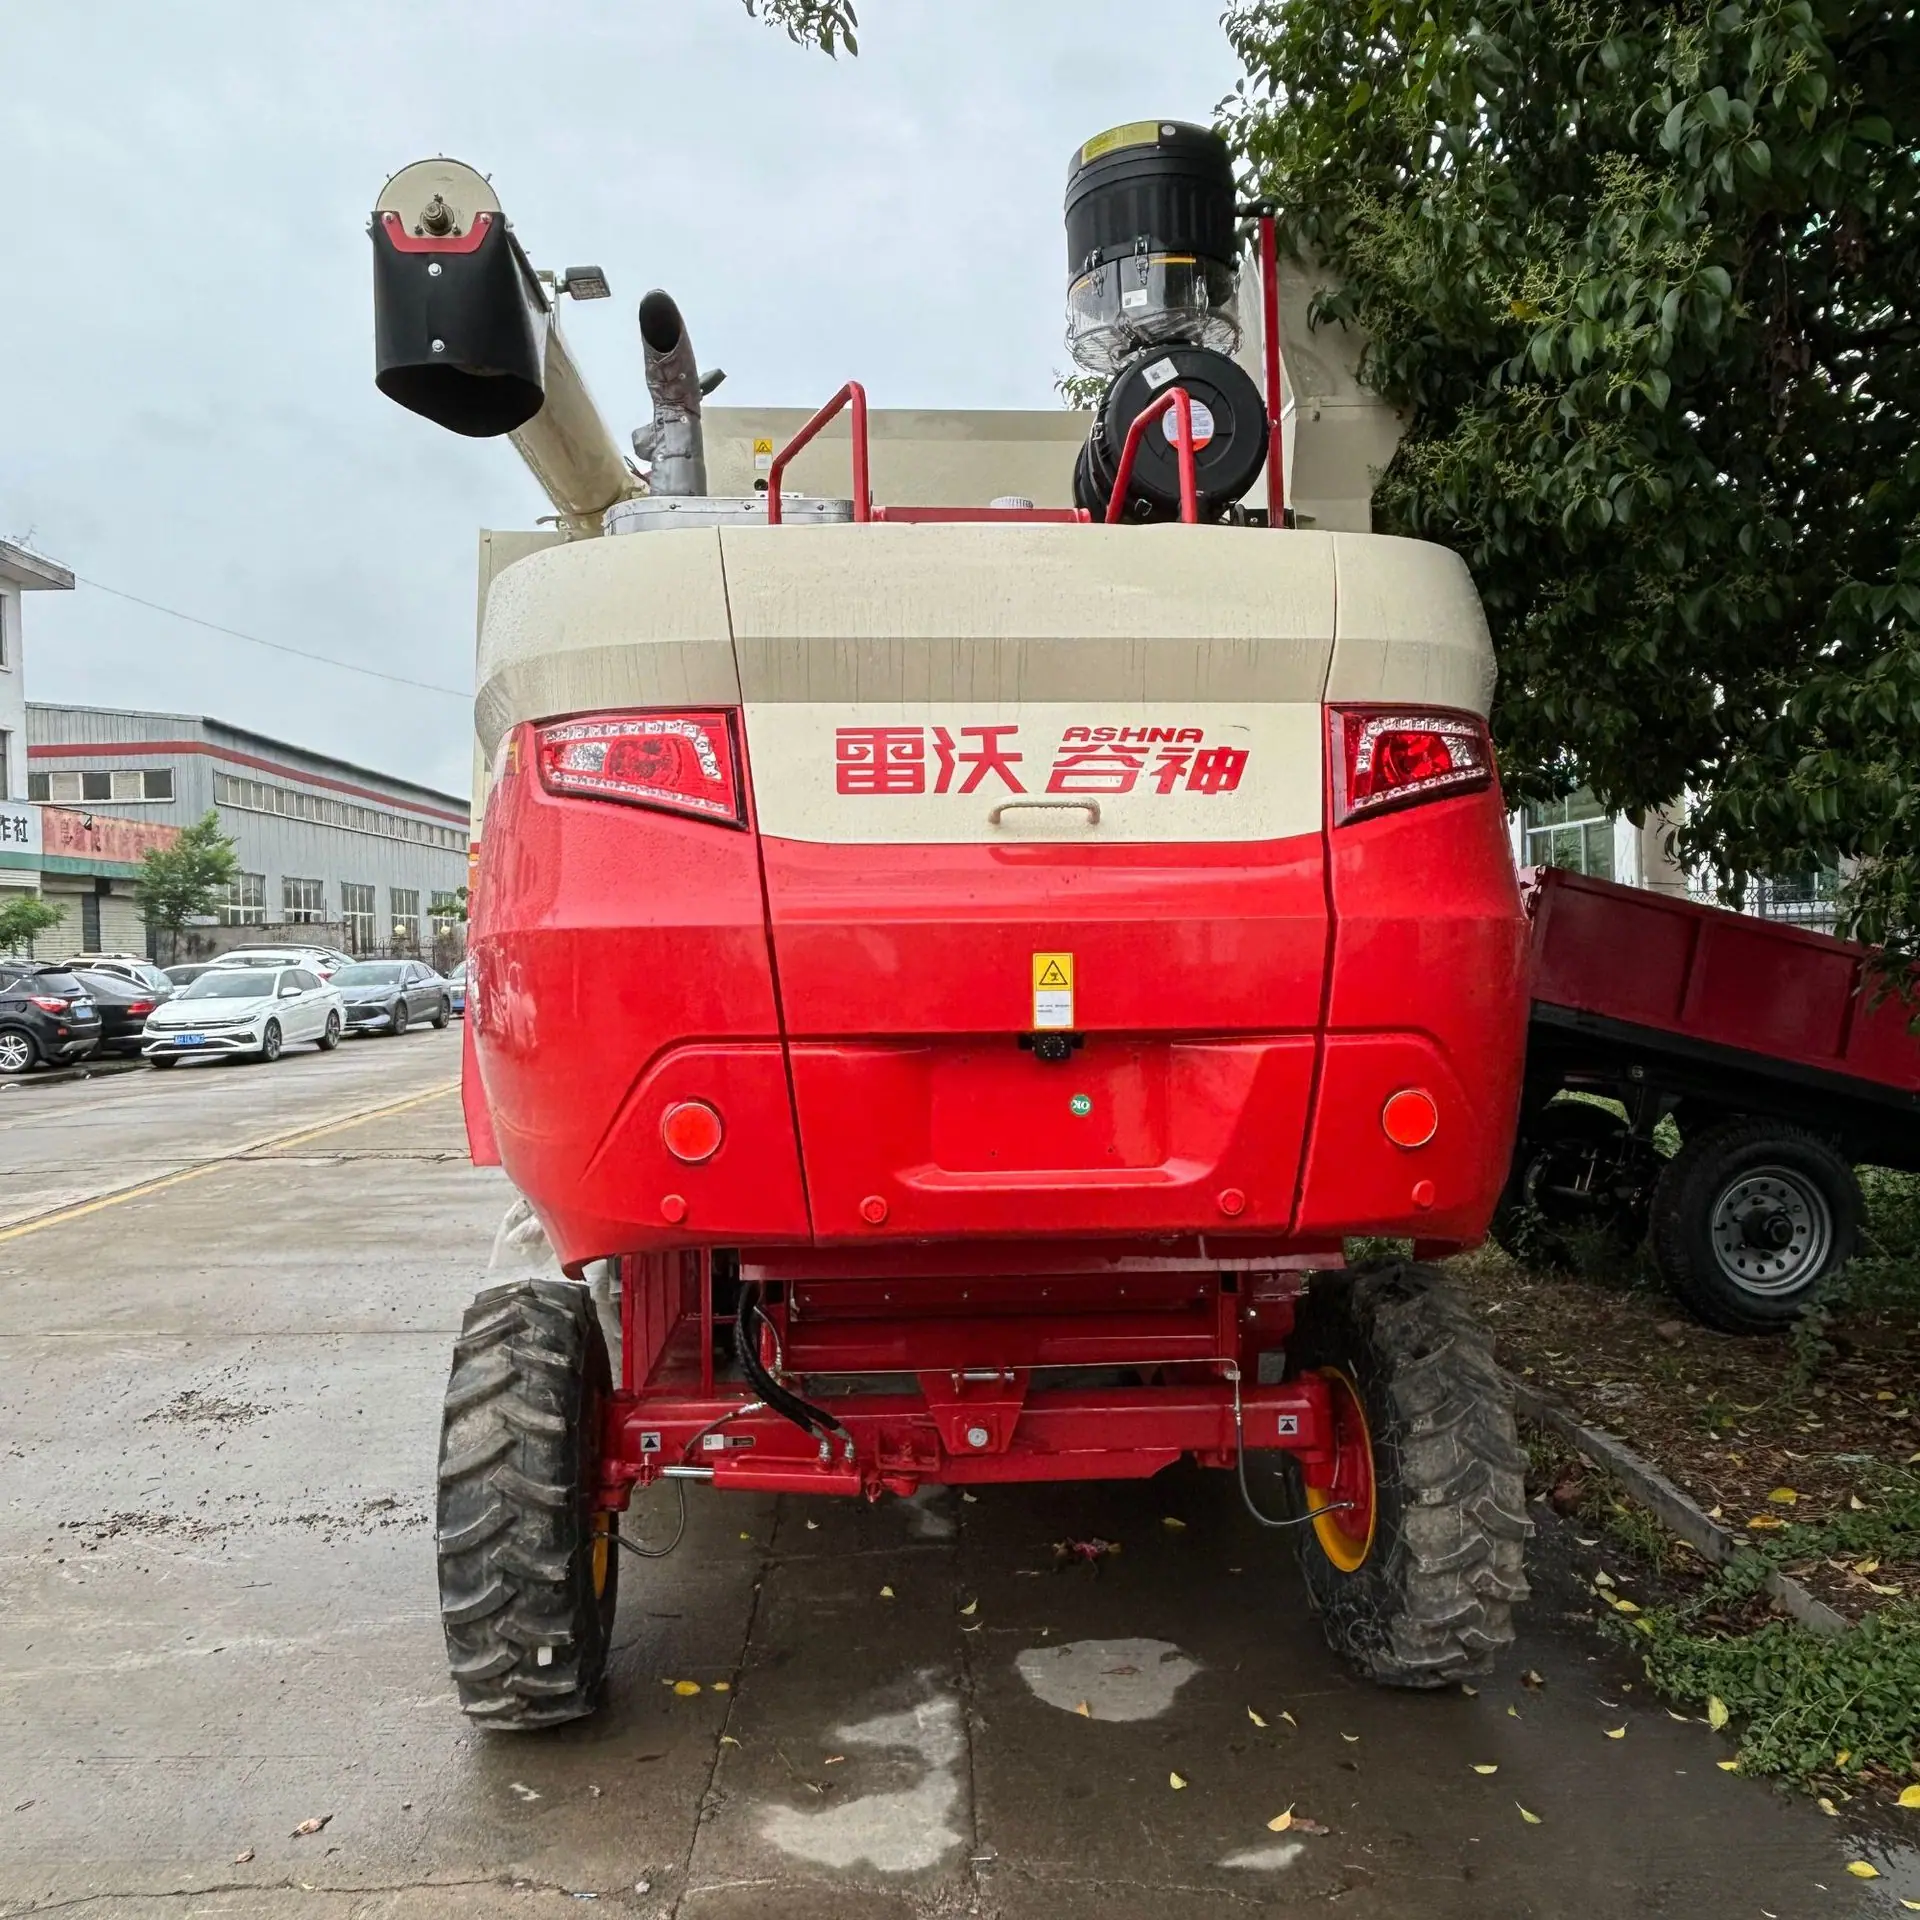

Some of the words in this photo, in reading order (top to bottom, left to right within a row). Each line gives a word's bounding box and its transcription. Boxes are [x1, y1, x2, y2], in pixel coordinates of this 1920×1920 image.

[1063, 727, 1204, 742] ASHNA
[836, 725, 1028, 794] 雷沃
[1045, 744, 1250, 795] 谷神
